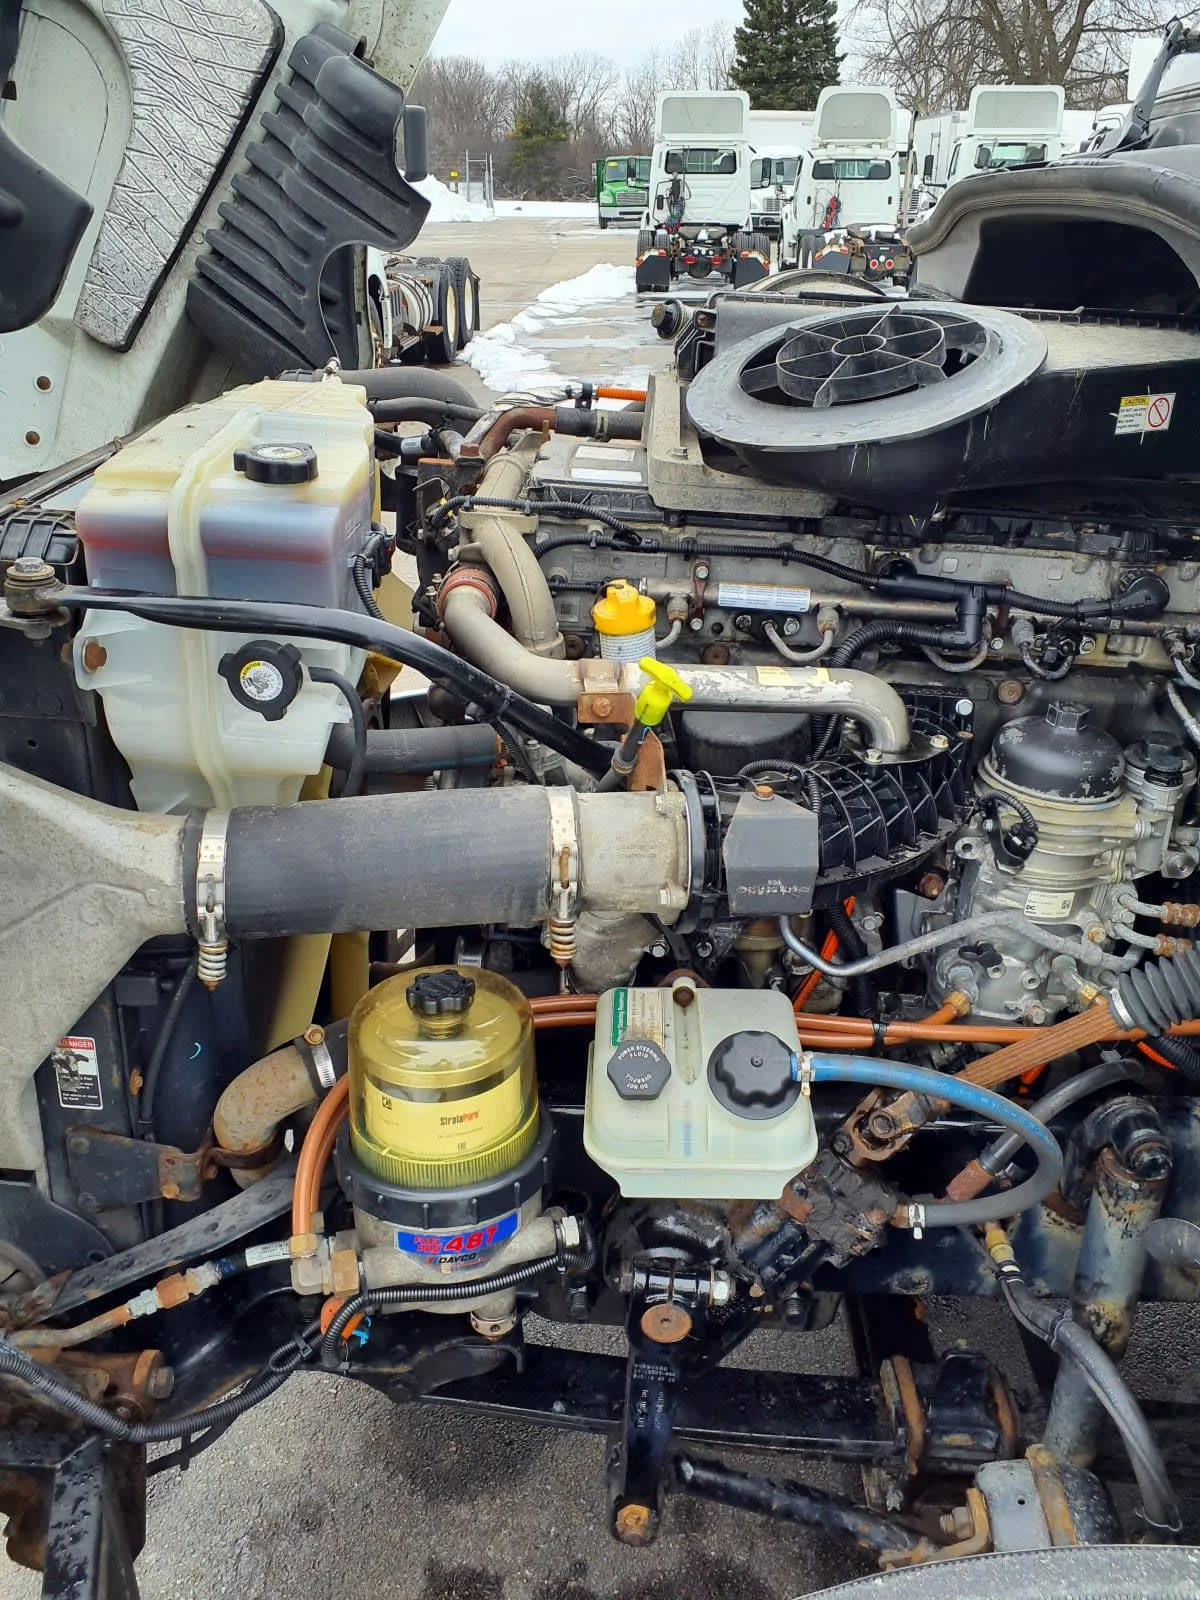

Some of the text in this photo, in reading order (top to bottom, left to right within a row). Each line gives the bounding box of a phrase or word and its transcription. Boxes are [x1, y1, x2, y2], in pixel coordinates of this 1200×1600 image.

[618, 1045, 661, 1062] POWER STEERING
[629, 1051, 649, 1059] FLUID
[625, 1073, 652, 1084] OVERFILL
[627, 1082, 638, 1090] NOT
[438, 1253, 477, 1264] DAVCO
